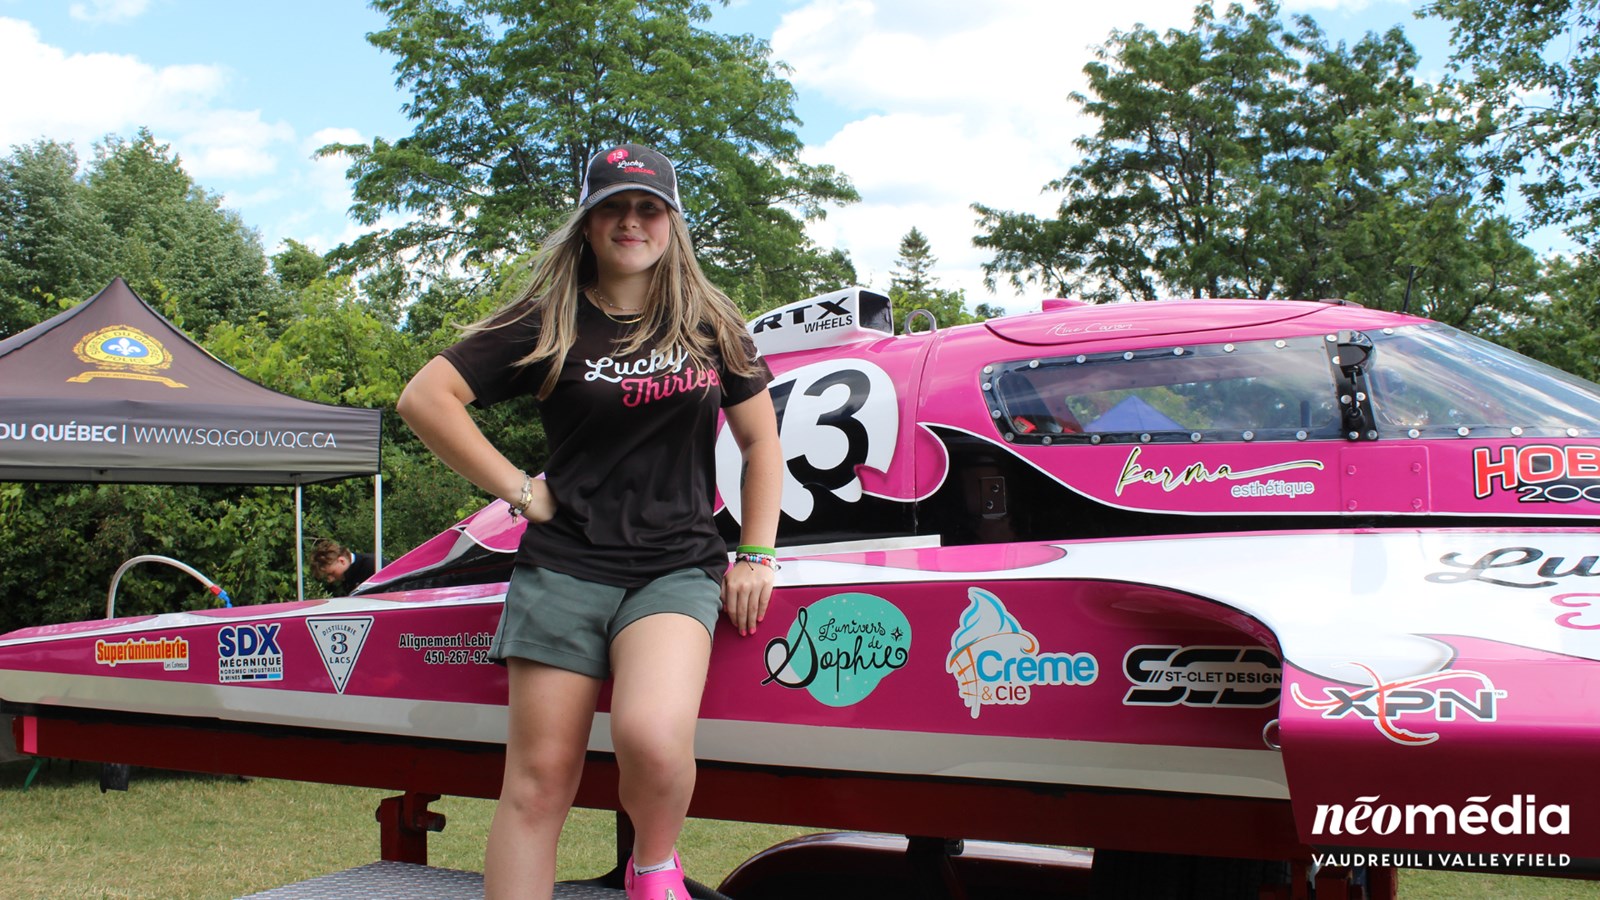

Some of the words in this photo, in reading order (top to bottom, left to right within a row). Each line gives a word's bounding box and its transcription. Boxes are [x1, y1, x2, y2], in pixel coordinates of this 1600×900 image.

[612, 151, 624, 160] 13
[617, 160, 645, 169] Lucky
[753, 297, 852, 334] RTX
[804, 315, 853, 334] WHEELS
[584, 345, 688, 383] Lucky
[0, 423, 26, 440] DU
[31, 421, 117, 442] QUÉBEC
[133, 427, 337, 448] WWW.SQ.GOUV.QC.CA
[1117, 448, 1323, 495] karma
[1473, 445, 1600, 498] HOB
[1231, 480, 1314, 498] esthétique
[322, 624, 357, 637] DISTILLERIE
[818, 618, 886, 641] L'univers
[219, 625, 281, 657] SDX
[331, 632, 348, 655] 3
[399, 634, 462, 650] Alignement
[761, 607, 908, 693] Sophie
[868, 636, 883, 649] de
[220, 657, 281, 668] MÉCANIQUE
[330, 656, 351, 664] LACS
[1165, 671, 1223, 683] ST-CLET
[1226, 672, 1282, 683] DESIGN
[981, 686, 992, 700] &
[995, 682, 1027, 701] cie
[1324, 688, 1495, 719] XPN
